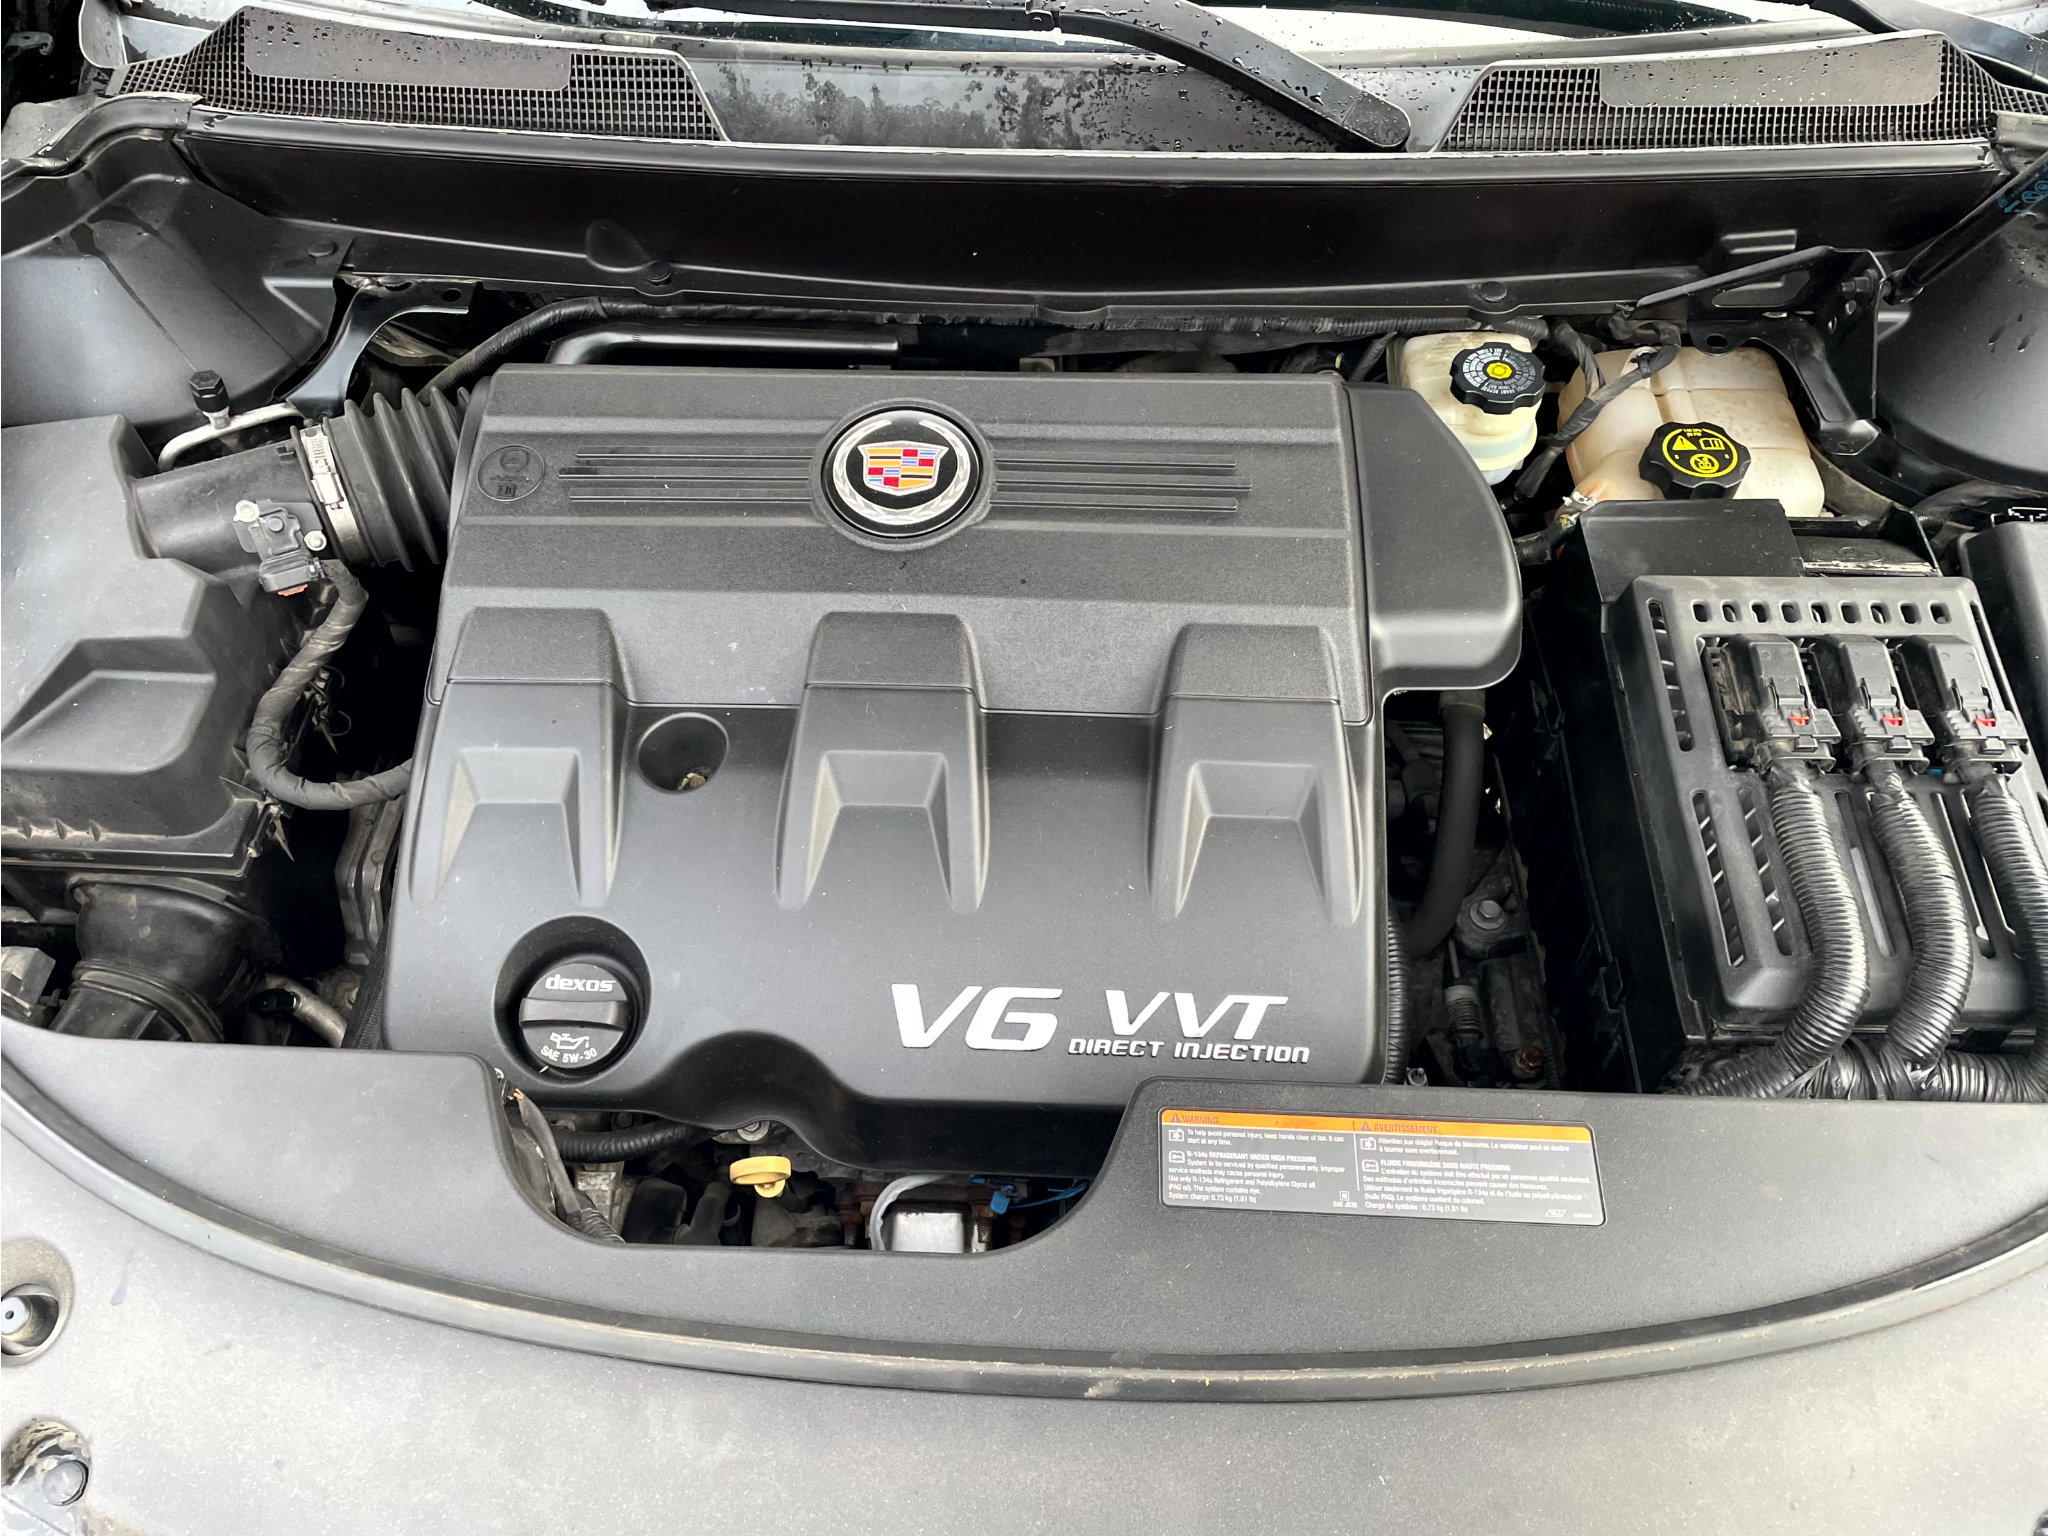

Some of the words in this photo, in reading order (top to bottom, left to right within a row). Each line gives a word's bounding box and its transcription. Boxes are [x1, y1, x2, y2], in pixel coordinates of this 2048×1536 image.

[545, 973, 617, 992] dexos
[890, 983, 1064, 1051] V6
[1105, 989, 1289, 1041] VVT
[540, 1045, 560, 1061] SAE
[562, 1047, 597, 1063] 5W-30
[1068, 1037, 1166, 1058] DIRECT
[1174, 1040, 1310, 1064] INJECTION
[1183, 1116, 1218, 1124] WARNING
[1374, 1124, 1437, 1134] AVERTISSEMENT
[1296, 1134, 1309, 1142] clear
[1209, 1152, 1248, 1160] REFRIGERANT
[1286, 1155, 1317, 1163] PRESSURE
[1187, 1159, 1207, 1167] System
[1224, 1161, 1246, 1169] serviced
[1255, 1162, 1278, 1170] qualified
[1279, 1164, 1306, 1172] personnel
[1381, 1159, 1401, 1167] FLUIDE
[1443, 1161, 1458, 1169] SOUS
[1460, 1162, 1479, 1170] HAUTE
[1480, 1163, 1510, 1171] PRESSION
[1190, 1168, 1213, 1176] methods
[1169, 1175, 1179, 1183] Use
[1180, 1176, 1191, 1184] only
[1193, 1177, 1213, 1185] R-134a
[1214, 1178, 1244, 1186] Refrigerant
[1245, 1179, 1255, 1187] and
[1256, 1180, 1290, 1188] Polyalkylene
[1291, 1181, 1308, 1189] Glycol
[1225, 1186, 1248, 1194] contains
[1366, 1202, 1385, 1210] Charge
